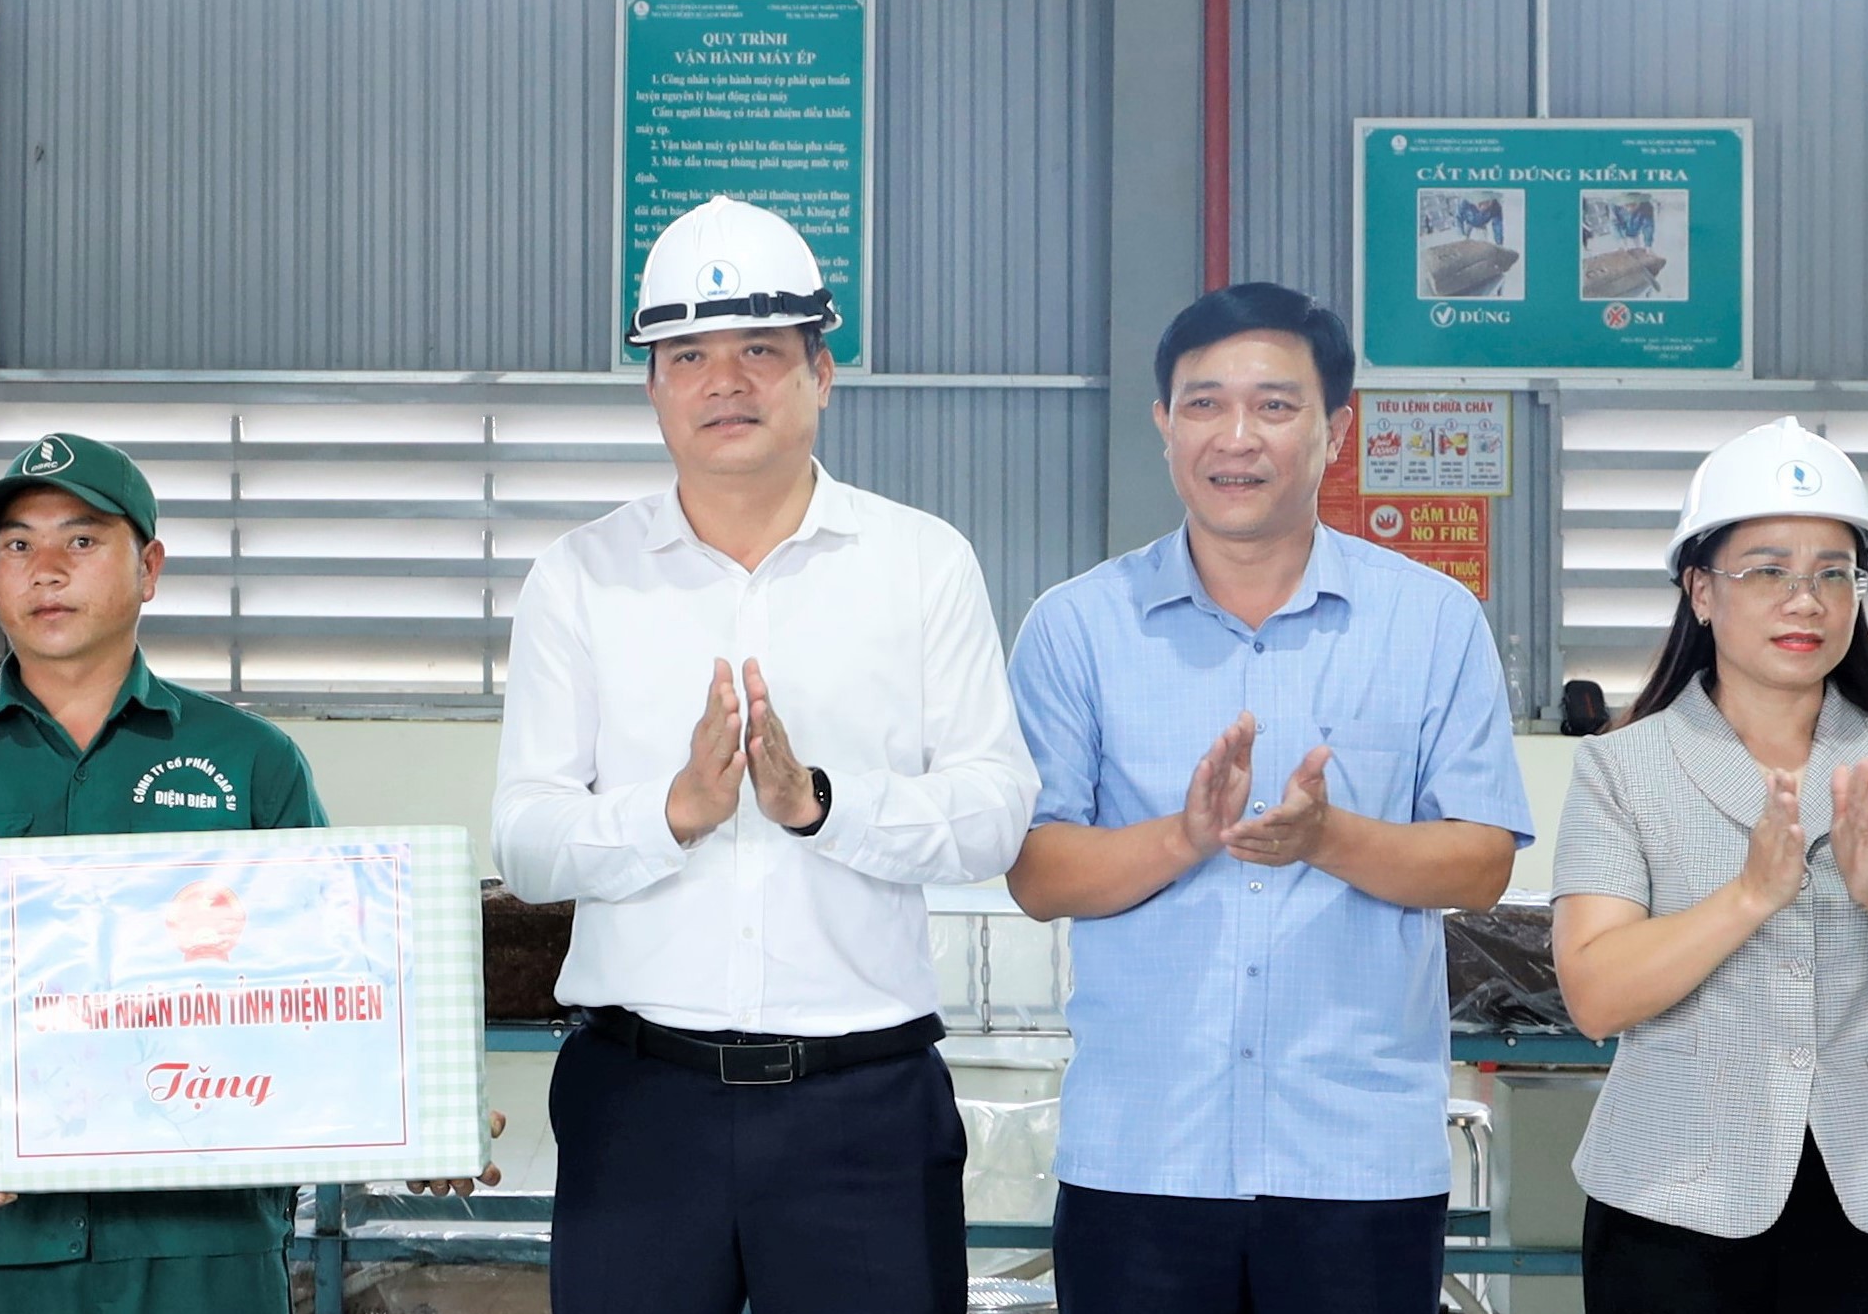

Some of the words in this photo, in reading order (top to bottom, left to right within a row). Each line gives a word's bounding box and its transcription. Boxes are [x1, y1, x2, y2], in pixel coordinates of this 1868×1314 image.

[702, 32, 735, 47] QUY
[739, 29, 789, 46] TRÌNH
[674, 47, 707, 67] VẬN
[710, 47, 755, 65] HÀNH
[758, 47, 793, 65] MÁY
[1416, 162, 1463, 181] CẮT
[1578, 162, 1637, 181] KIỂM
[1643, 168, 1689, 181] TRA
[1634, 311, 1665, 324] SAI
[1410, 501, 1445, 522] CẤM
[1448, 502, 1479, 522] LỬA
[1411, 526, 1435, 541] NO
[1440, 526, 1479, 541] FIRE
[150, 764, 165, 777] TY
[213, 773, 233, 793] CAO
[225, 794, 237, 812] SU
[187, 793, 218, 809] BIÊN
[115, 984, 173, 1029] NHÂN
[178, 982, 221, 1027] DÂN
[227, 975, 274, 1025] TỈNH
[280, 979, 328, 1031] ĐIỆN
[334, 976, 382, 1021] BIÊN
[146, 1062, 276, 1110] Tặng
